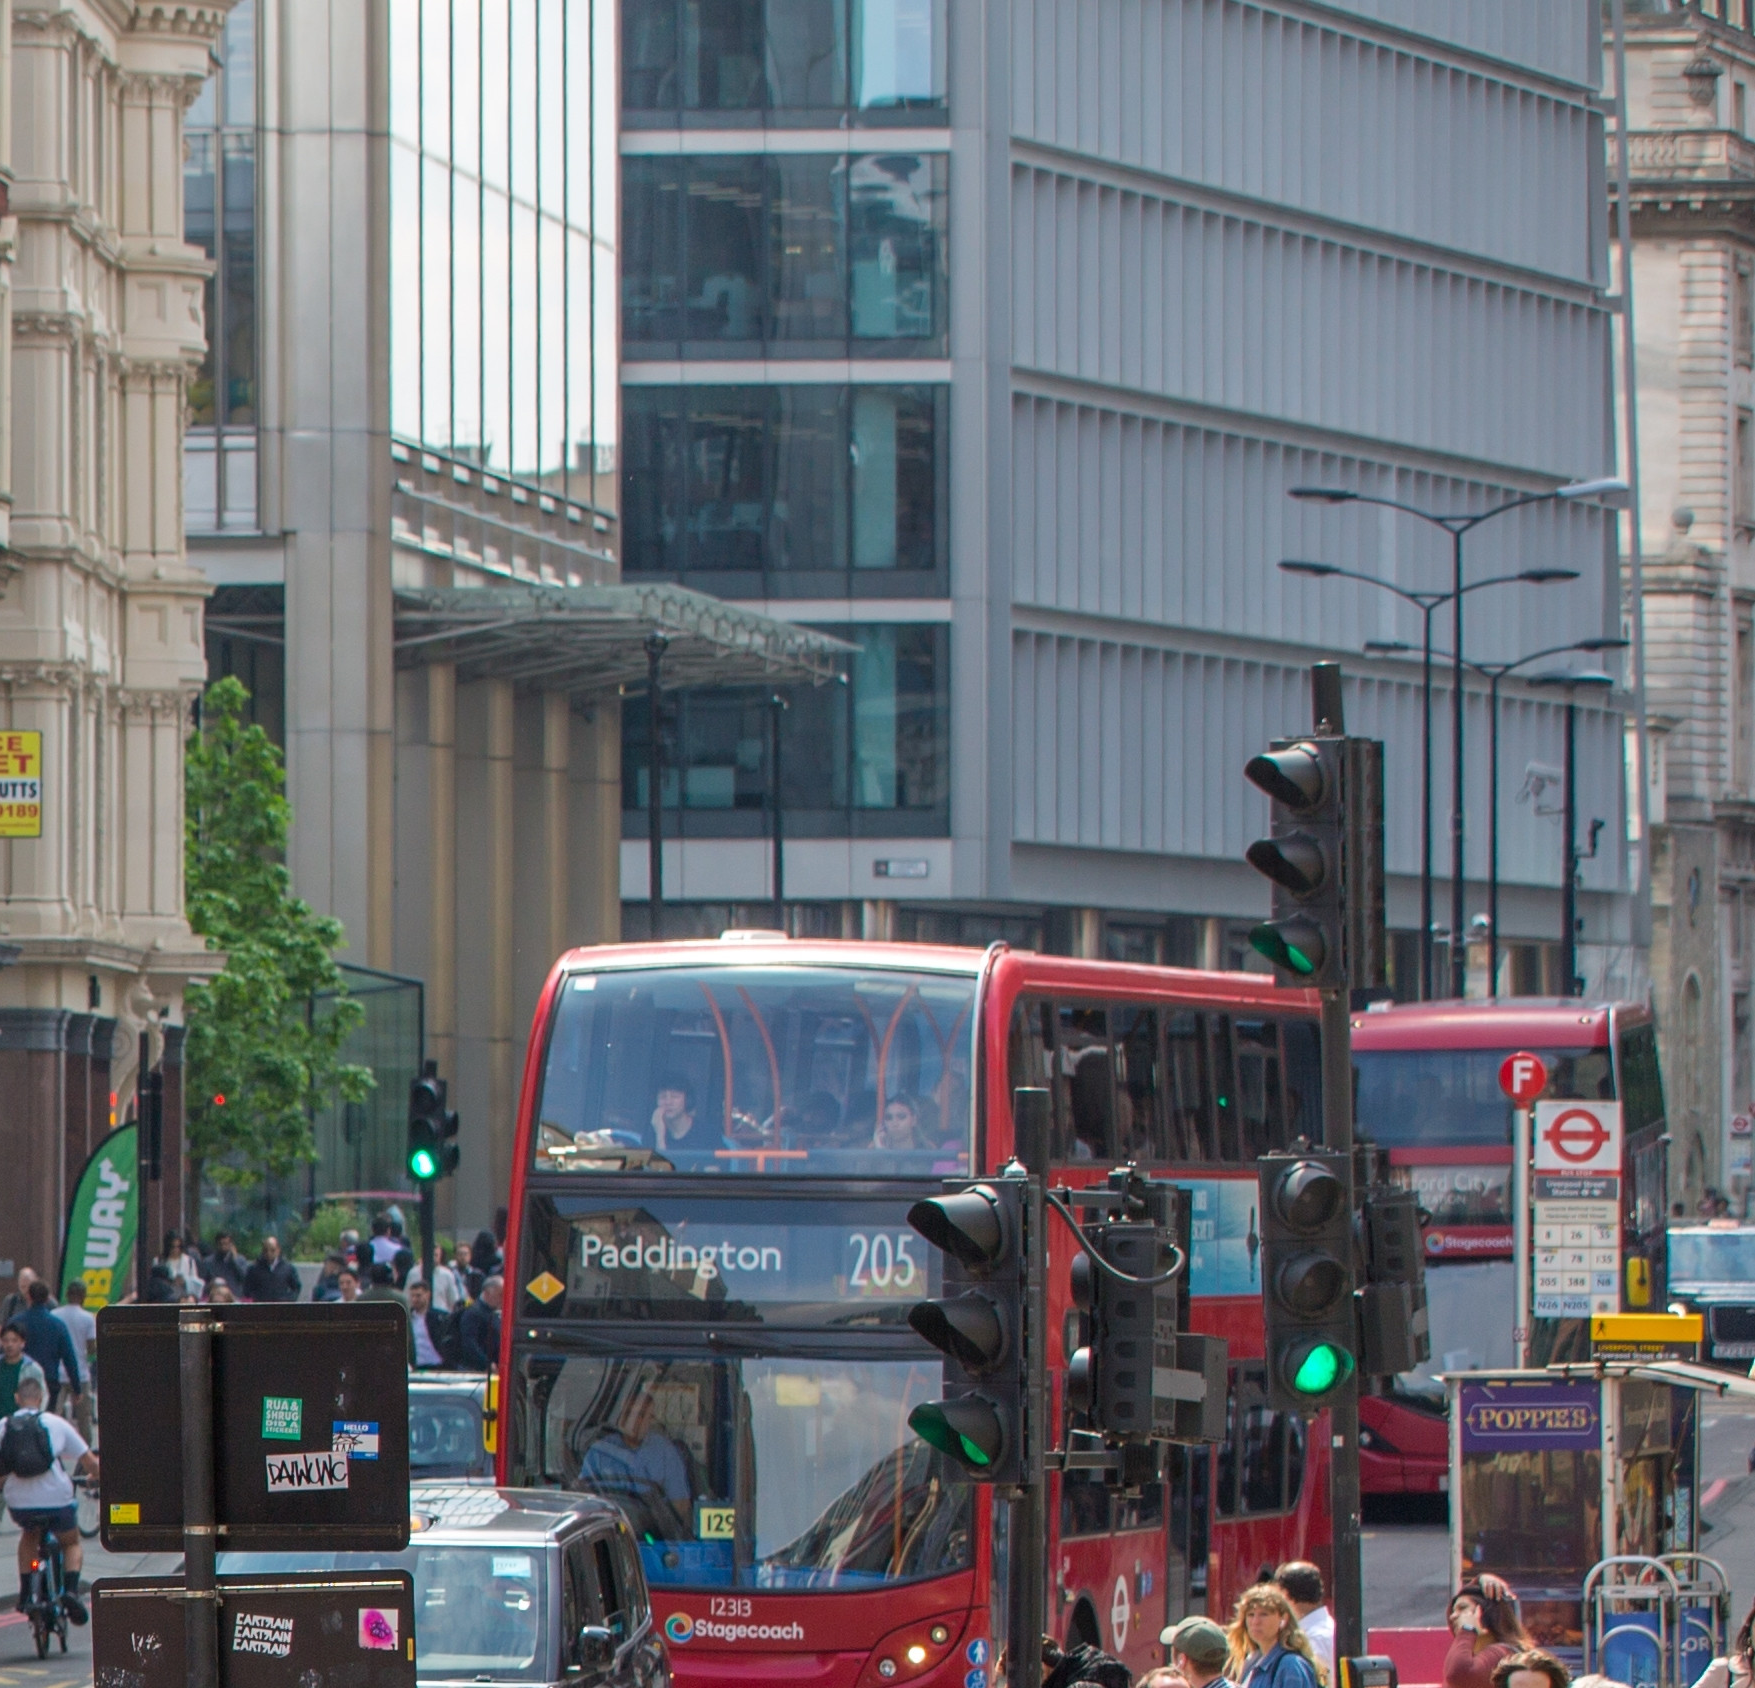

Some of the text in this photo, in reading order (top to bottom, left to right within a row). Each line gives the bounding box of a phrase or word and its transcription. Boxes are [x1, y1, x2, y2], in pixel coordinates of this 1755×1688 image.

[1512, 1060, 1534, 1095] F
[1583, 1180, 1607, 1188] Street
[1551, 1189, 1578, 1197] Station
[581, 1233, 916, 1288] Paddington 205
[1543, 1255, 1555, 1264] 47
[1540, 1278, 1557, 1287] 205
[1537, 1301, 1588, 1310] N26 N205
[265, 1399, 299, 1411] RUA &
[265, 1410, 299, 1421] SHRUG
[343, 1423, 369, 1432] HELLO
[710, 1598, 753, 1618] 12313
[695, 1619, 804, 1643] Stagecoach
